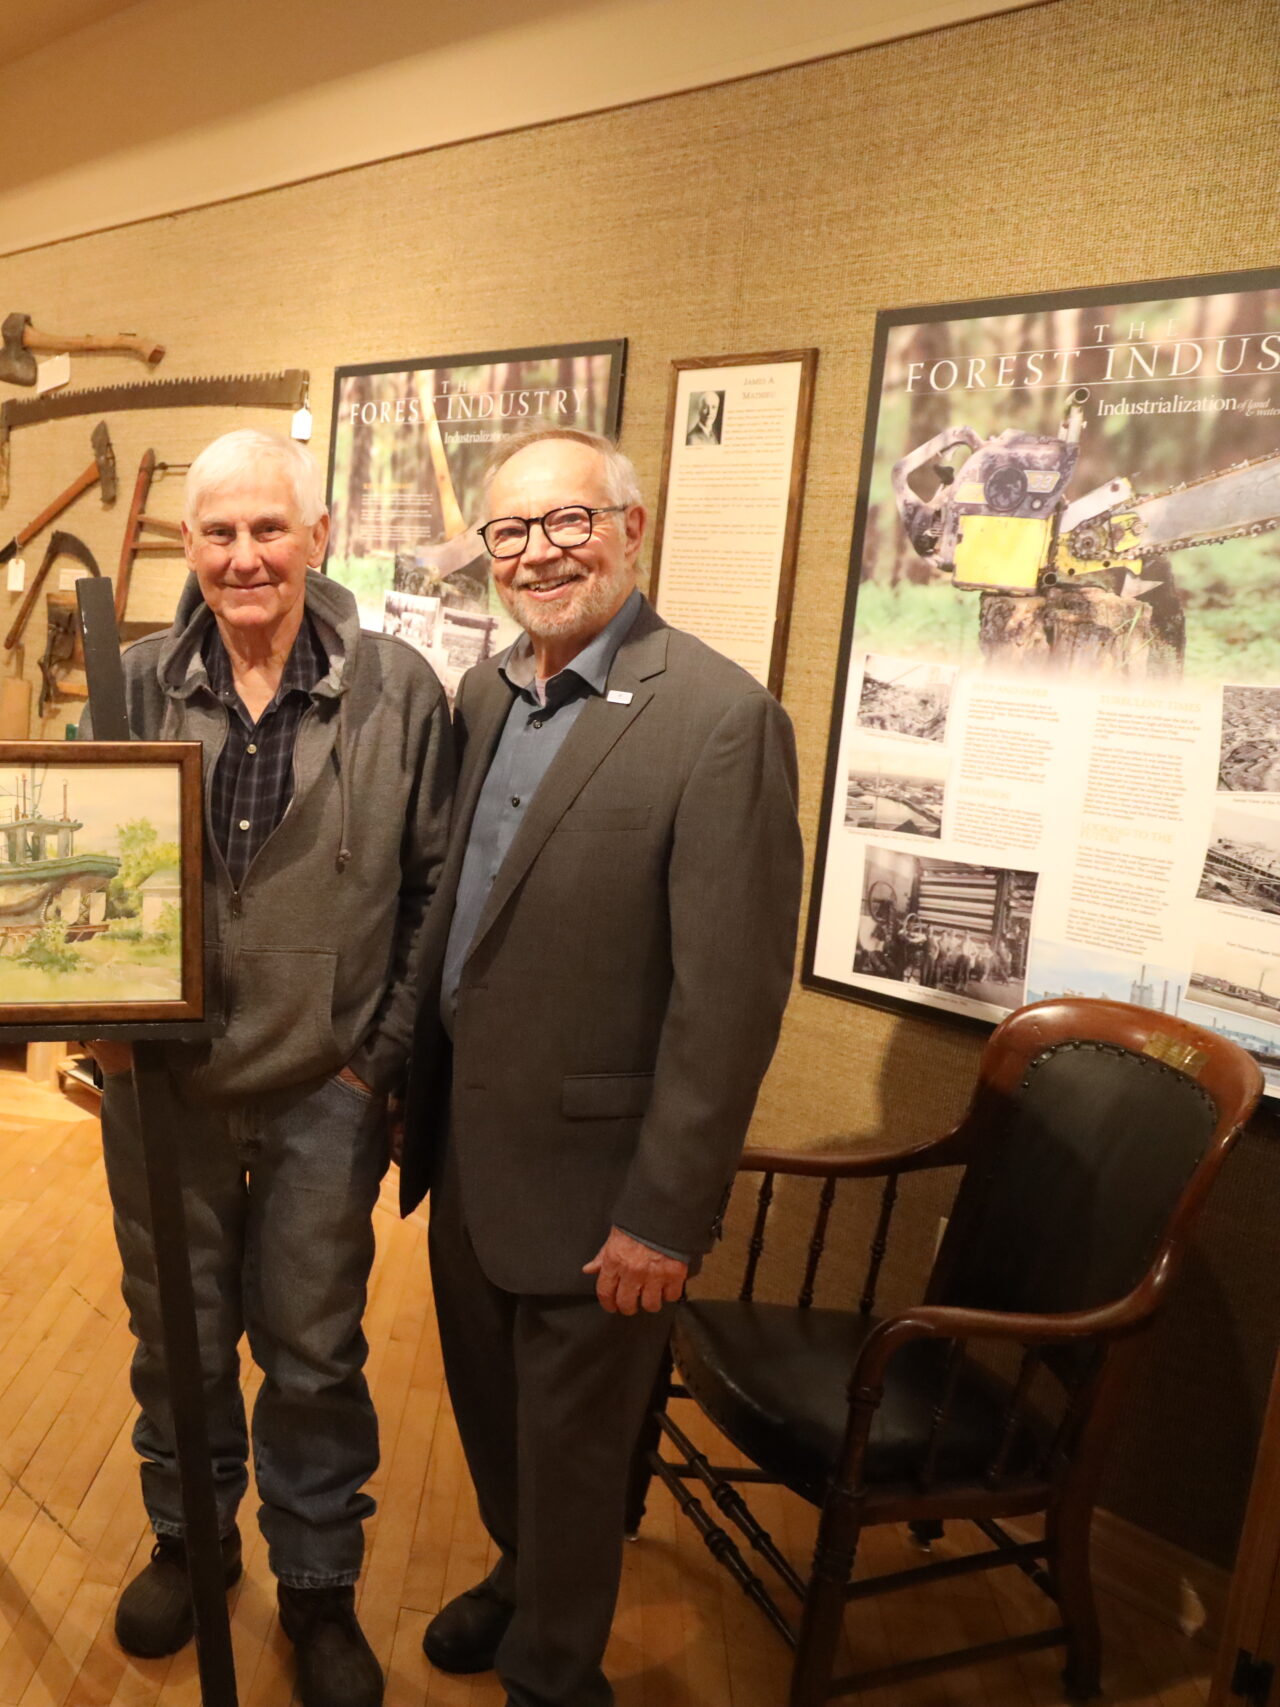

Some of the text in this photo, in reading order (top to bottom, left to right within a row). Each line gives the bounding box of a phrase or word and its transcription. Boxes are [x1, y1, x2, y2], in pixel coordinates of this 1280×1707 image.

[1093, 317, 1180, 343] THE
[904, 334, 1280, 393] FOREST INDUS
[349, 387, 589, 425] FORES INDUSTRY
[1096, 394, 1237, 417] Industrialization
